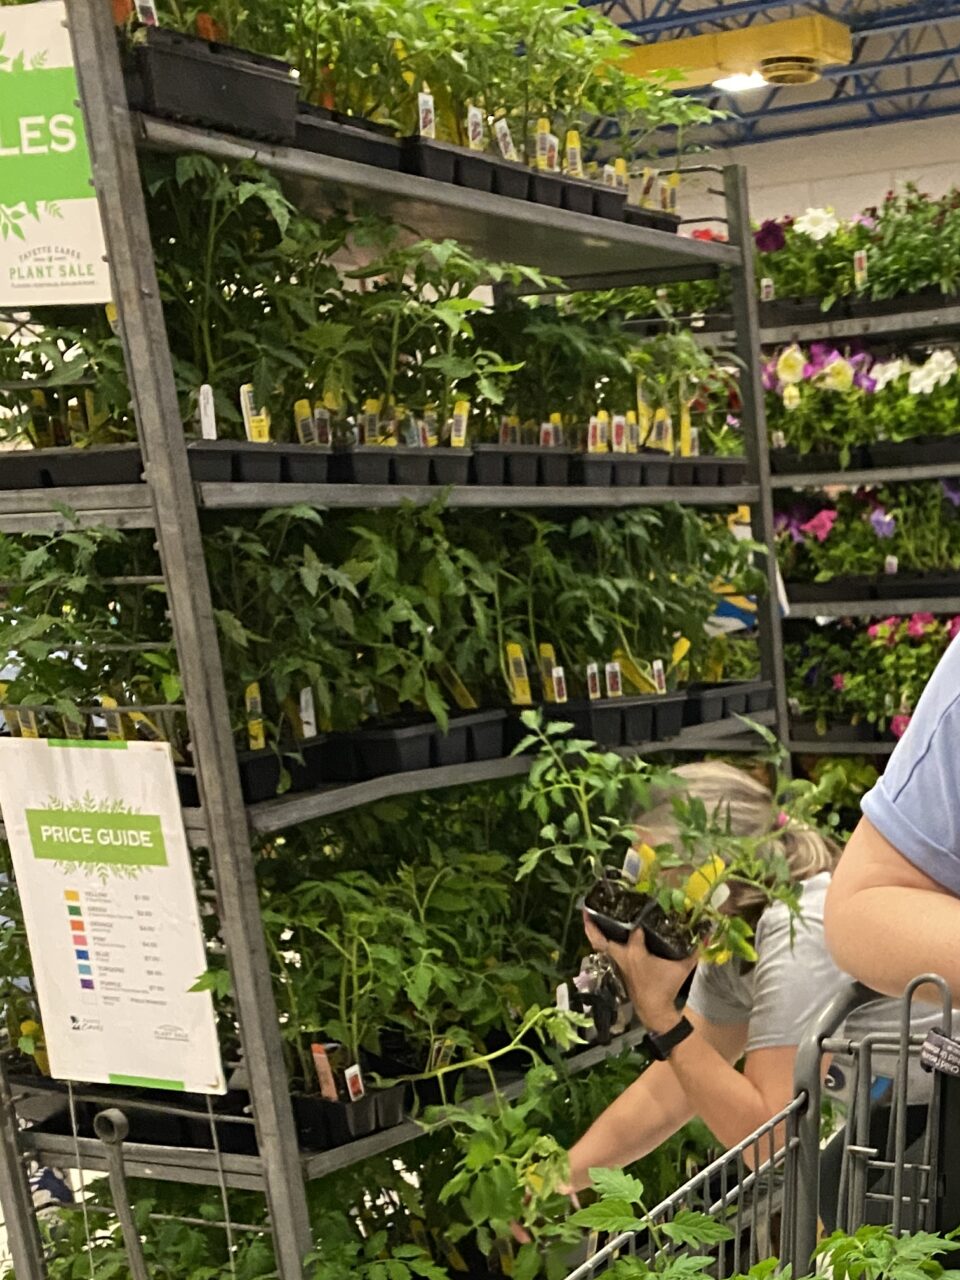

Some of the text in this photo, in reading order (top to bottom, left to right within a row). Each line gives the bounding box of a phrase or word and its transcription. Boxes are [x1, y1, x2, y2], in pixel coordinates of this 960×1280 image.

[9, 263, 95, 280] PLANT SALE
[41, 825, 154, 848] PRICE GUIDE
